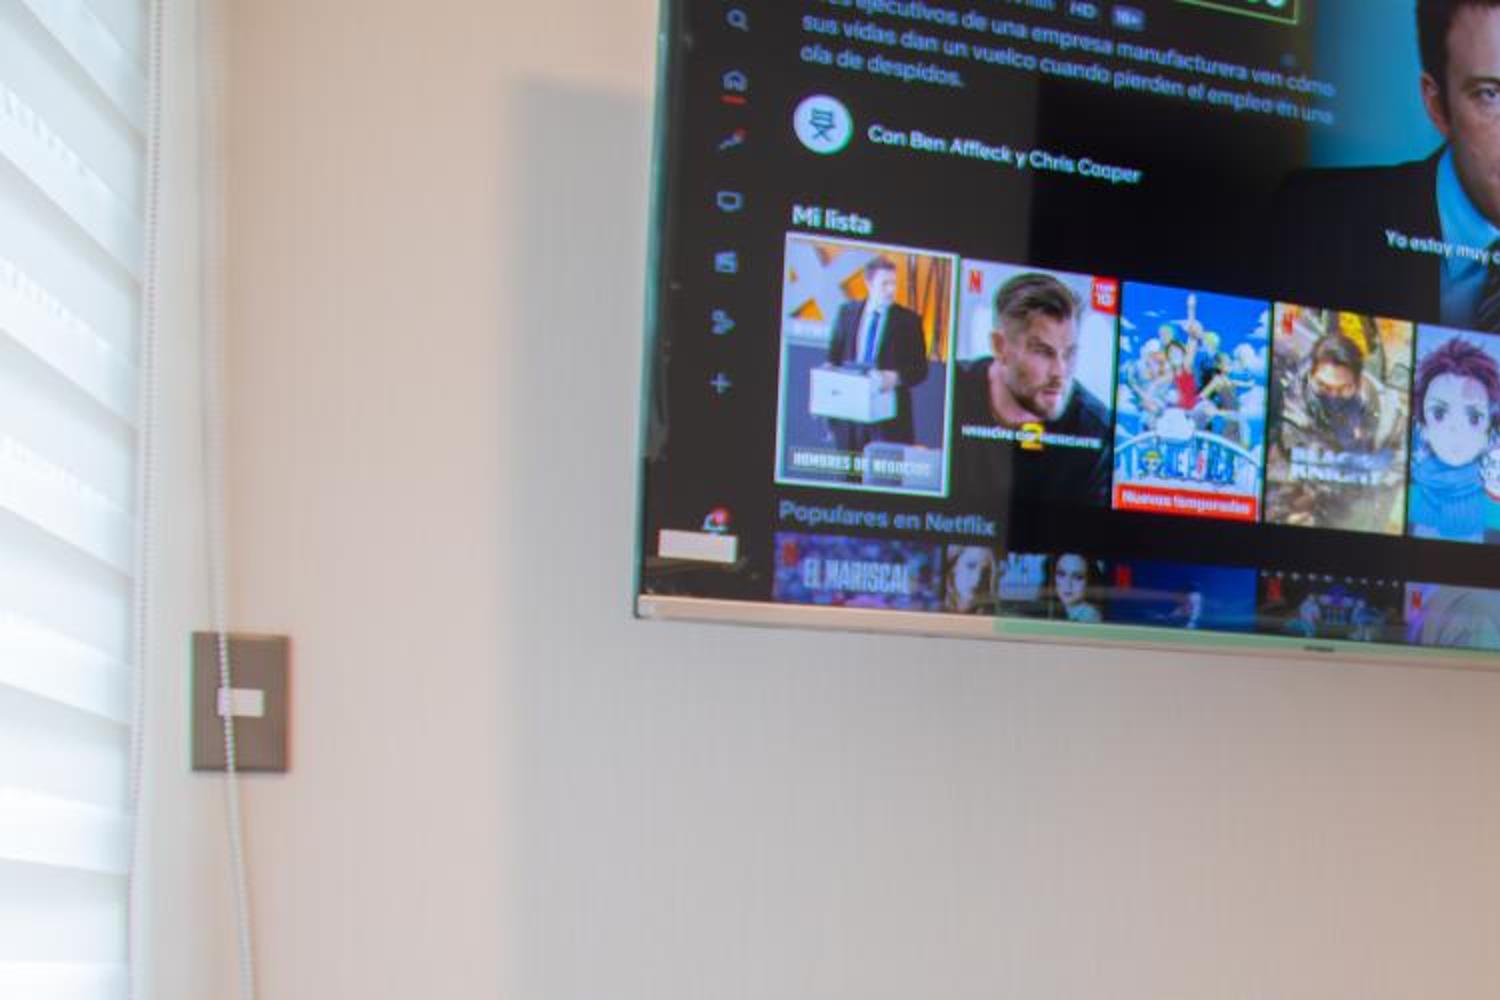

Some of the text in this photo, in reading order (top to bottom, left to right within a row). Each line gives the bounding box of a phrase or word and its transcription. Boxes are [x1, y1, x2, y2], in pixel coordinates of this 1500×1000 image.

[856, 0, 958, 26] ejecutivos
[961, 10, 987, 31] de
[991, 18, 1027, 38] una
[1031, 26, 1113, 55] empresa
[1116, 40, 1249, 81] manufacturera
[1251, 68, 1283, 87] ven
[801, 45, 965, 88] ola de despidos.
[802, 15, 1334, 125] sus vidas dan un vuelco cuando pierden el empleo en una
[868, 124, 1143, 184] Con Ben Affleck y Chris Cooper
[792, 205, 873, 234] Mi lista
[1385, 229, 1406, 249] Yo
[1410, 238, 1452, 257] estoy
[1456, 246, 1488, 265] muy
[792, 450, 851, 472] HOMBRES
[778, 500, 997, 537] Populares en Netflix
[803, 557, 911, 595] EL MARISCAL
